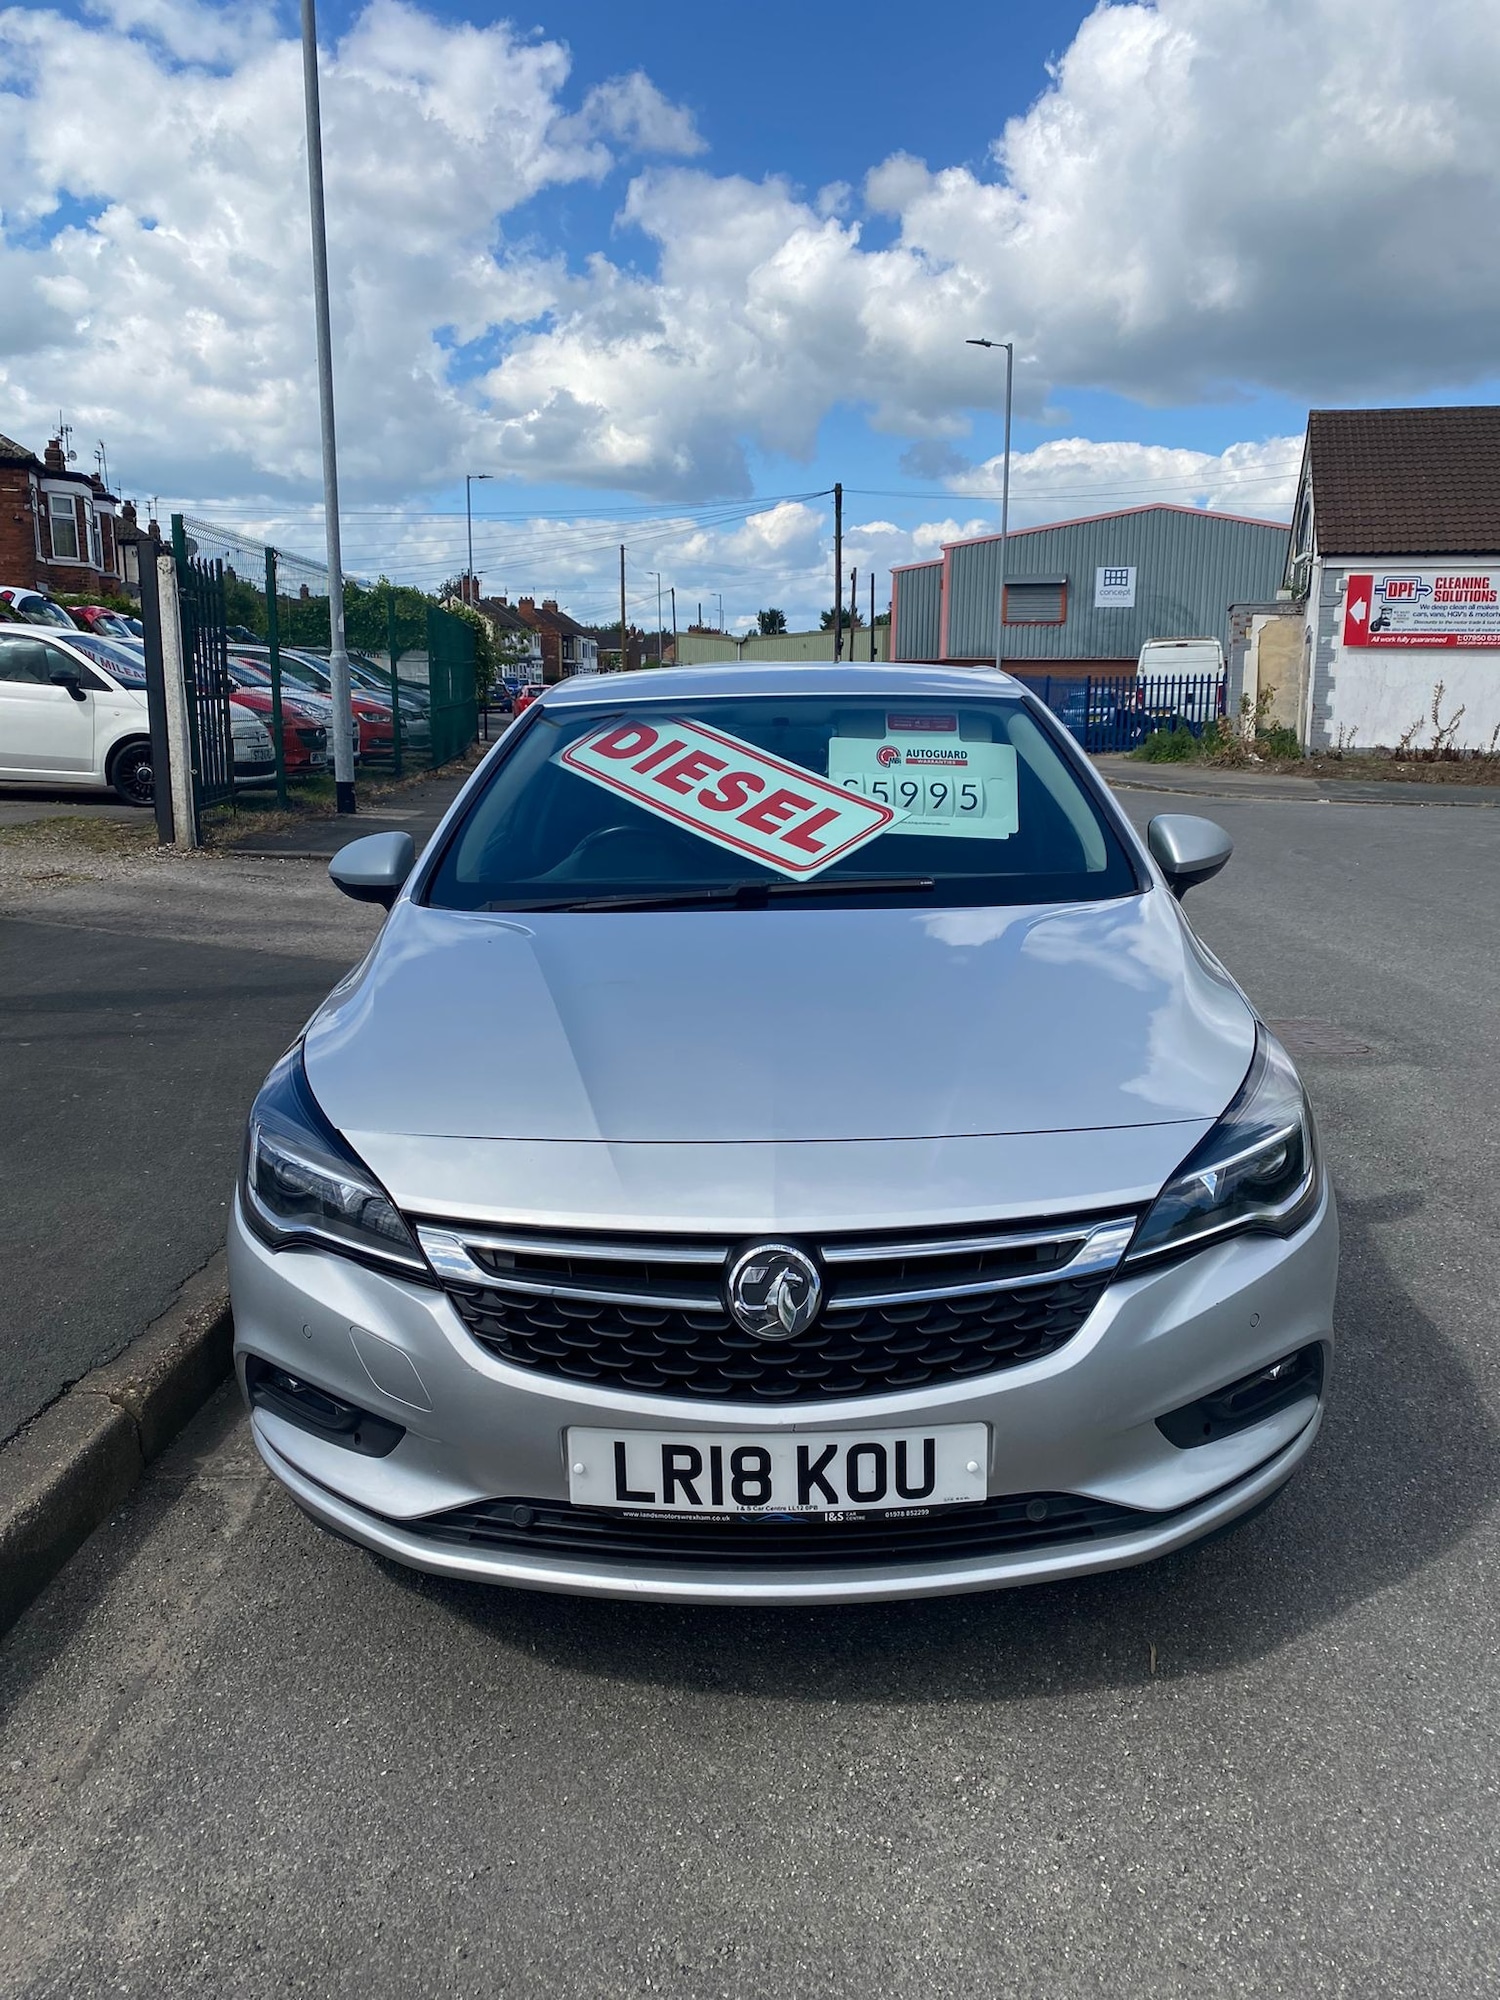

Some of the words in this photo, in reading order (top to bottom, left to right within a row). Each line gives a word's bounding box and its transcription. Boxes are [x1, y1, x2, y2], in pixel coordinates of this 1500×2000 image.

[1387, 582, 1416, 598] DPF
[1435, 576, 1490, 590] CLEANING
[1099, 588, 1131, 598] concept
[1433, 589, 1498, 603] SOLUTIONS
[1397, 636, 1411, 644] fully
[1410, 636, 1448, 644] guaranteed
[906, 748, 968, 760] AUTOGUARD
[589, 720, 842, 854] DIESEL
[613, 1440, 773, 1507] LR18
[796, 1437, 936, 1506] KOU
[824, 1511, 844, 1522] I&S
